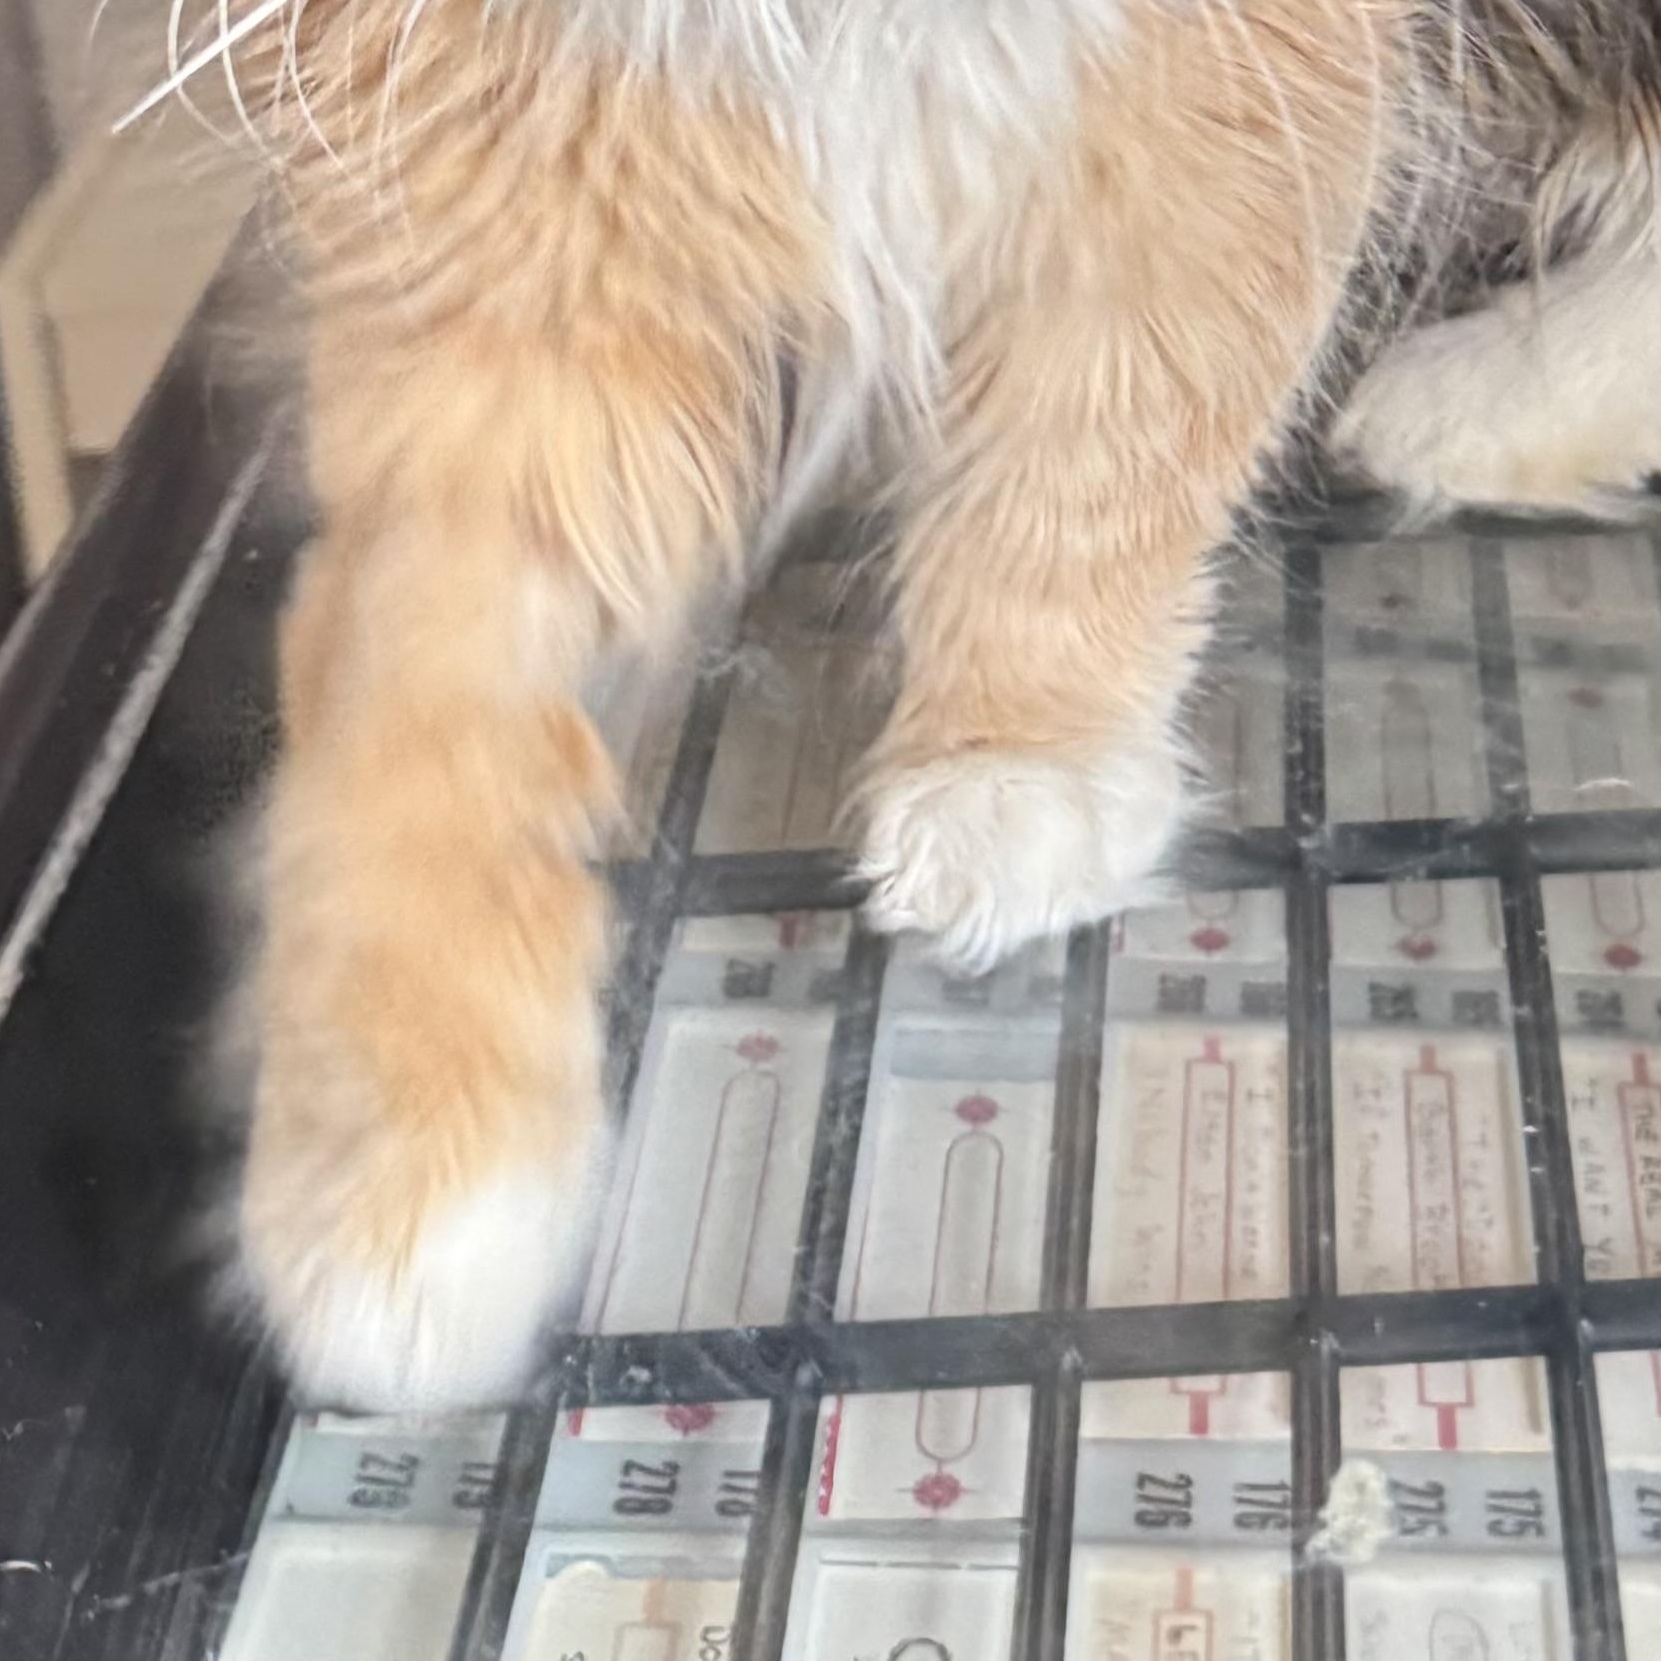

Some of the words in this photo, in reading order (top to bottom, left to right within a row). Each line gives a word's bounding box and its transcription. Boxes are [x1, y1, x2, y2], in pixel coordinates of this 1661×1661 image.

[612, 1458, 681, 1516] 278
[1133, 1472, 1193, 1529] 276
[1232, 1479, 1291, 1531] 176
[1388, 1480, 1448, 1538] 275
[1486, 1487, 1546, 1538] 175
